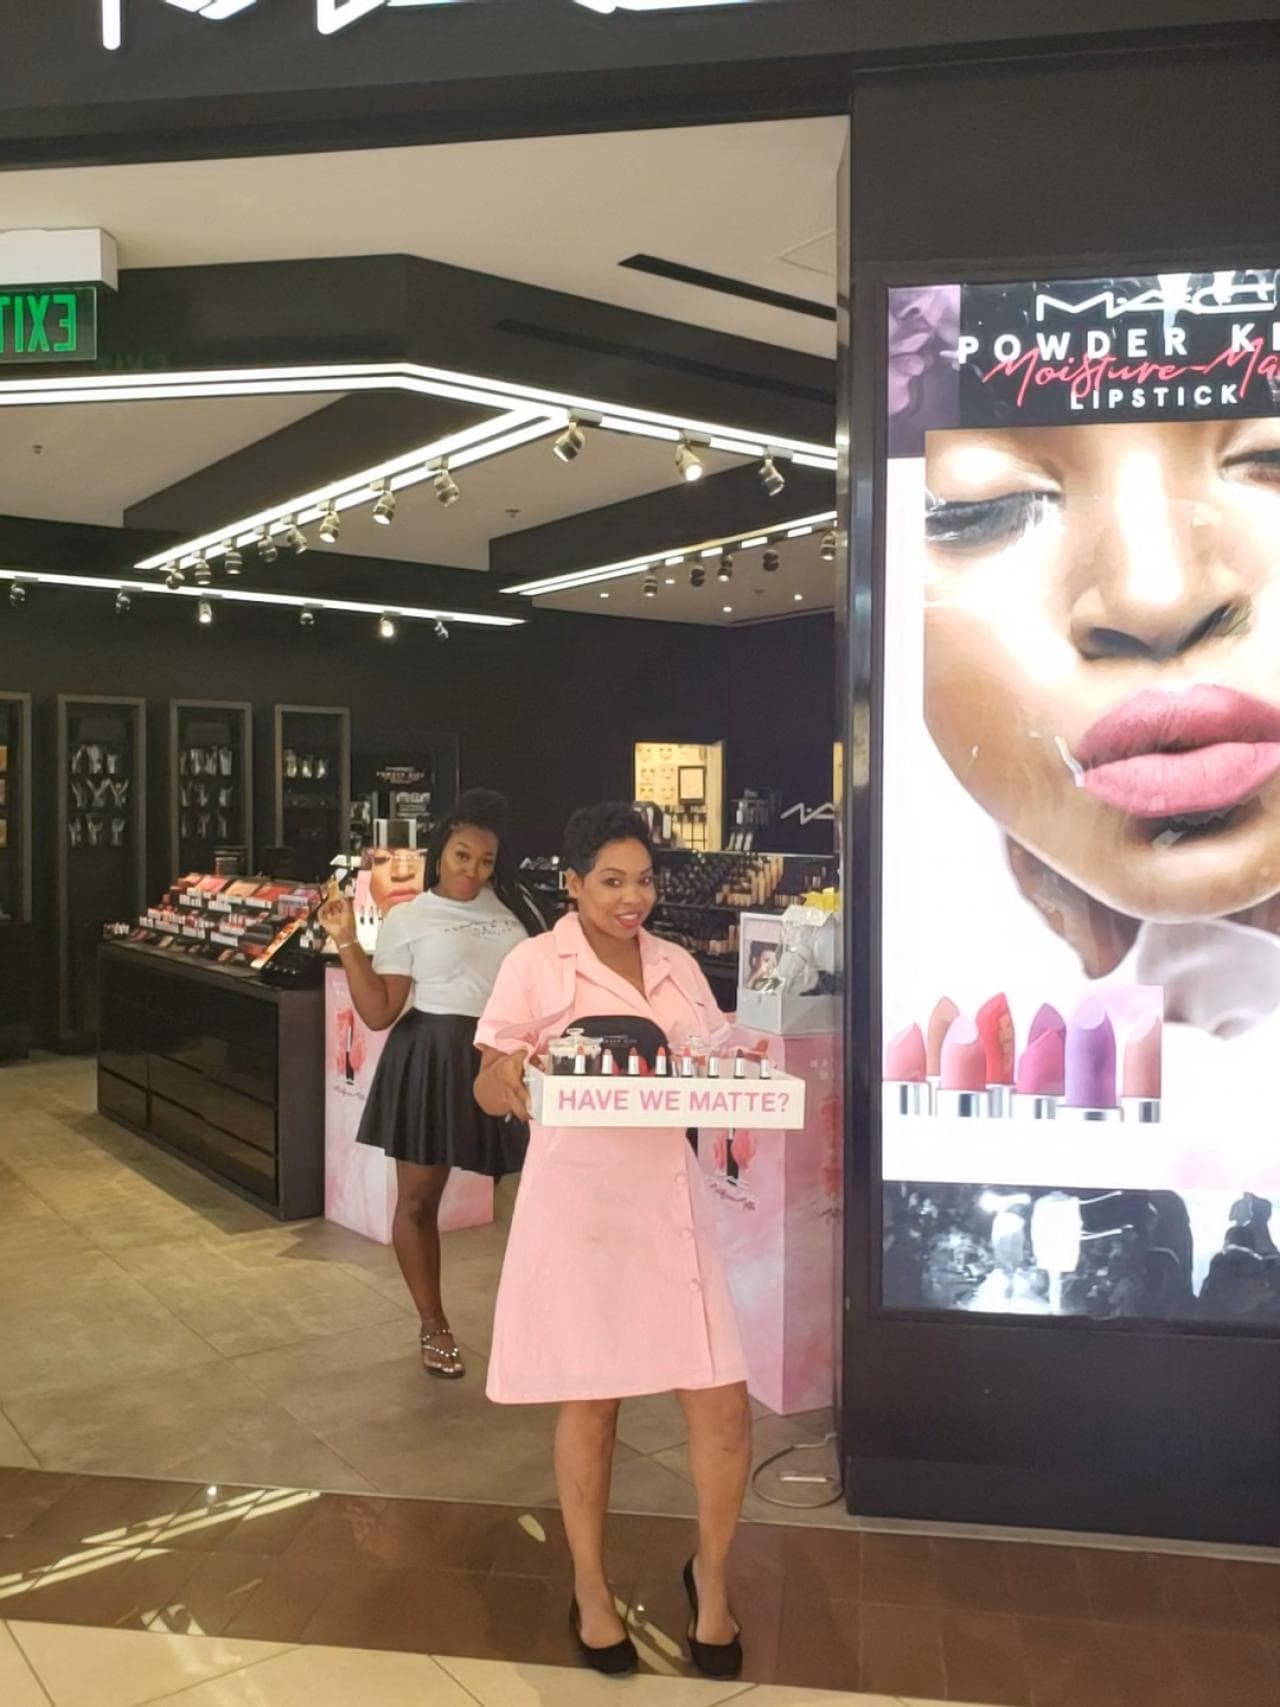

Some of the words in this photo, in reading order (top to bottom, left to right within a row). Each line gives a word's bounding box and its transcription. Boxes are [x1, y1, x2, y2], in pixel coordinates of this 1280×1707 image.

[957, 327, 1188, 365] POWDER
[1070, 384, 1238, 411] LIPSTICK
[557, 1088, 629, 1112] HAVE
[639, 1090, 681, 1112] WE
[689, 1090, 790, 1113] MATTE?
